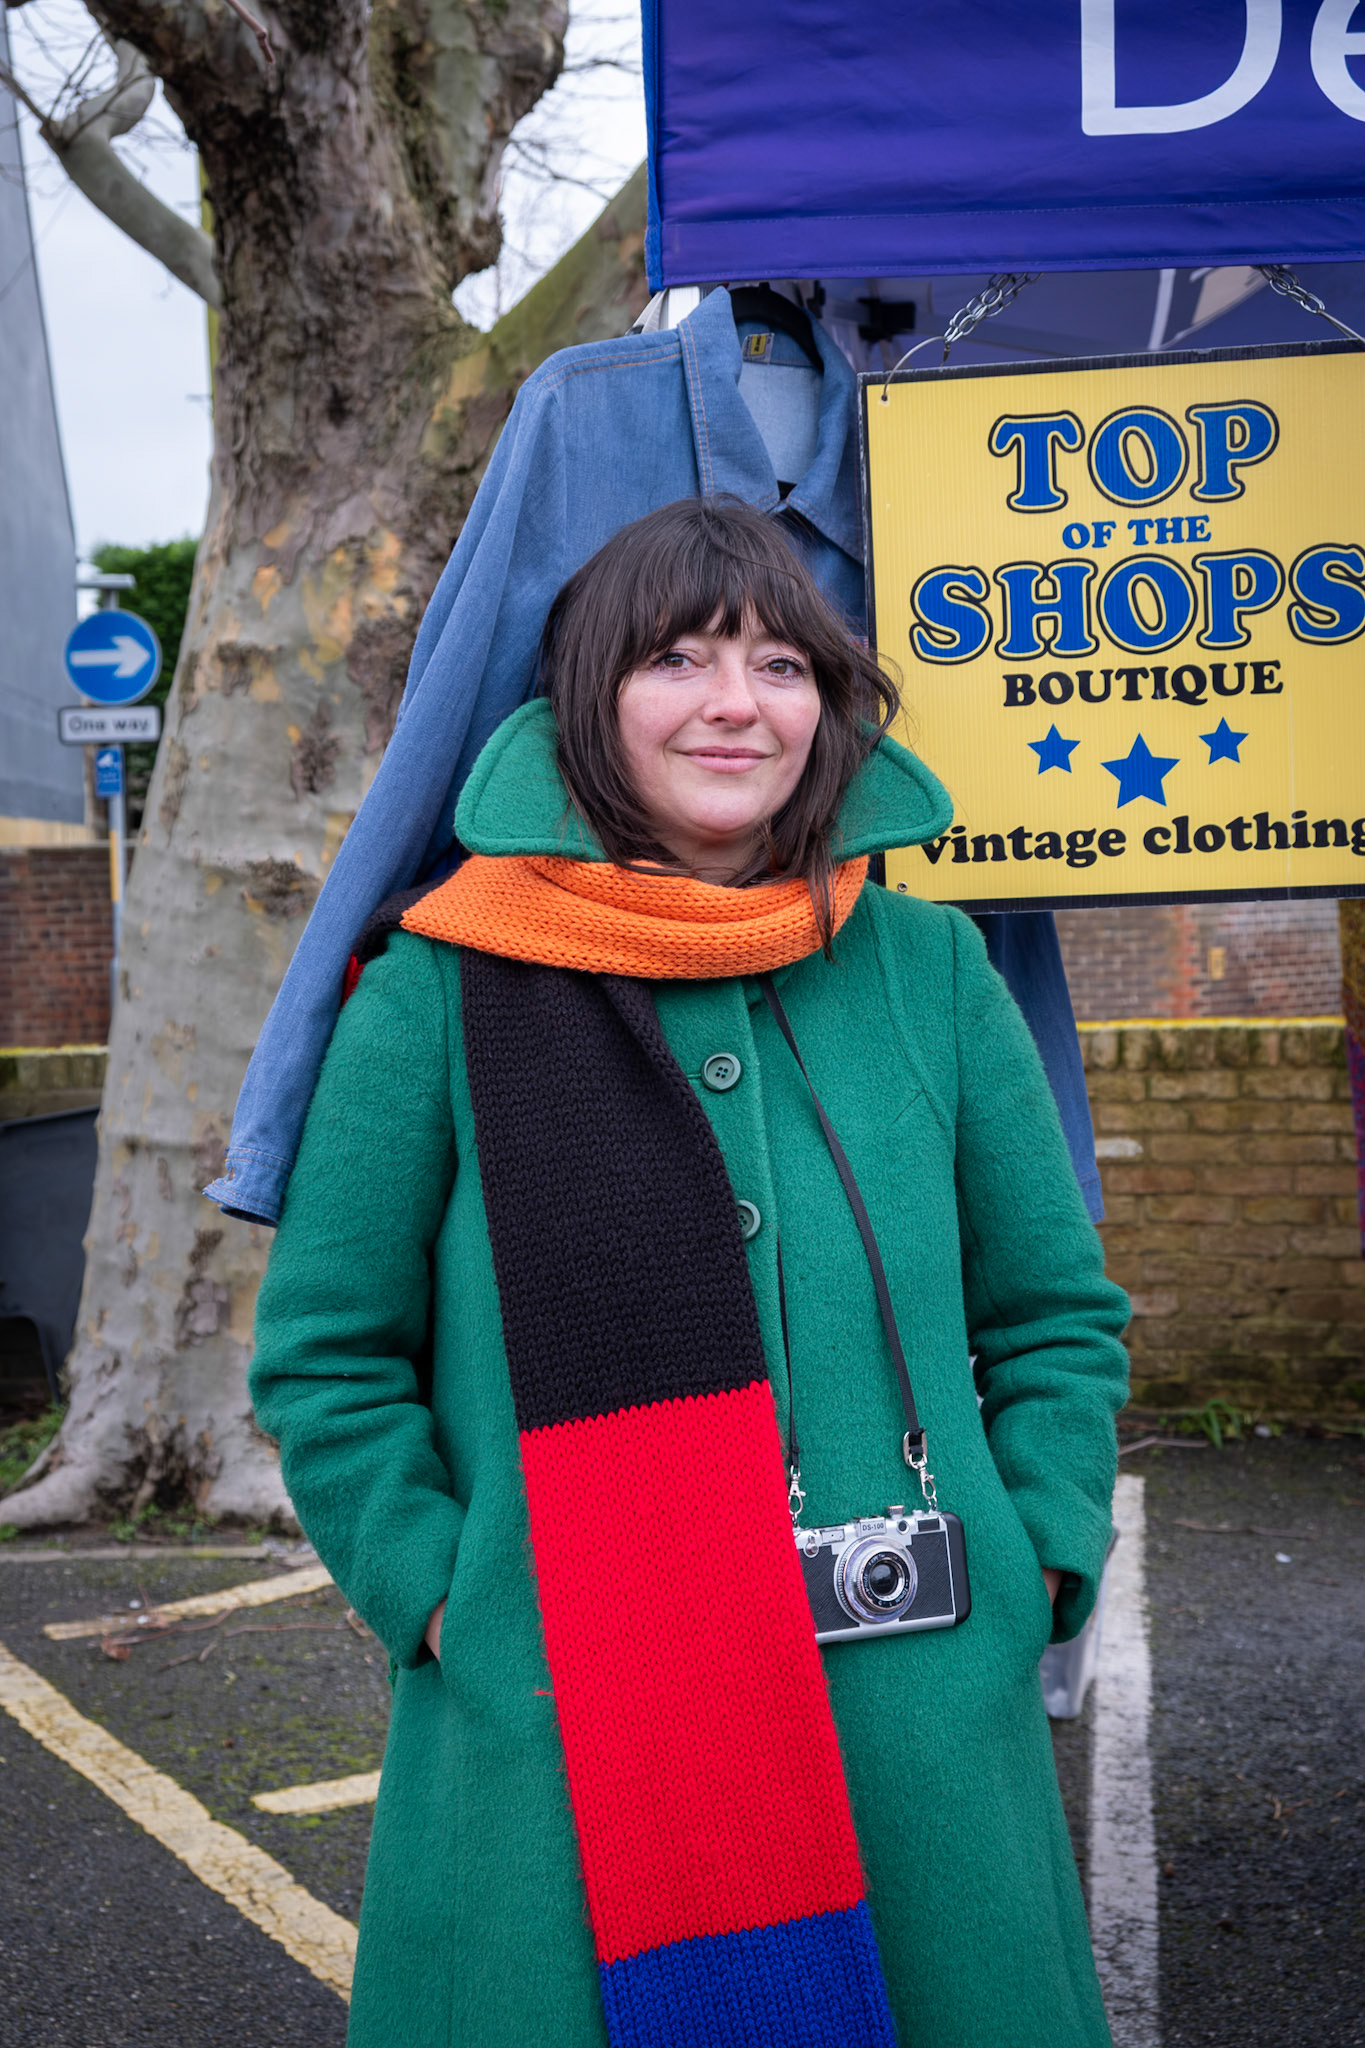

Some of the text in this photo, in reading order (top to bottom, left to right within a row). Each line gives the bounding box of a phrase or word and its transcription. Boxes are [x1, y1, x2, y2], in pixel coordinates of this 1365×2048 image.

[987, 399, 1280, 514] TOP
[1061, 515, 1212, 549] OF THE
[909, 543, 1365, 665] SHOPS
[1003, 661, 1283, 706] BOUTIQUE
[68, 717, 149, 733] One way
[920, 811, 1365, 868] vintage clothing
[862, 1522, 885, 1531] DS-100
